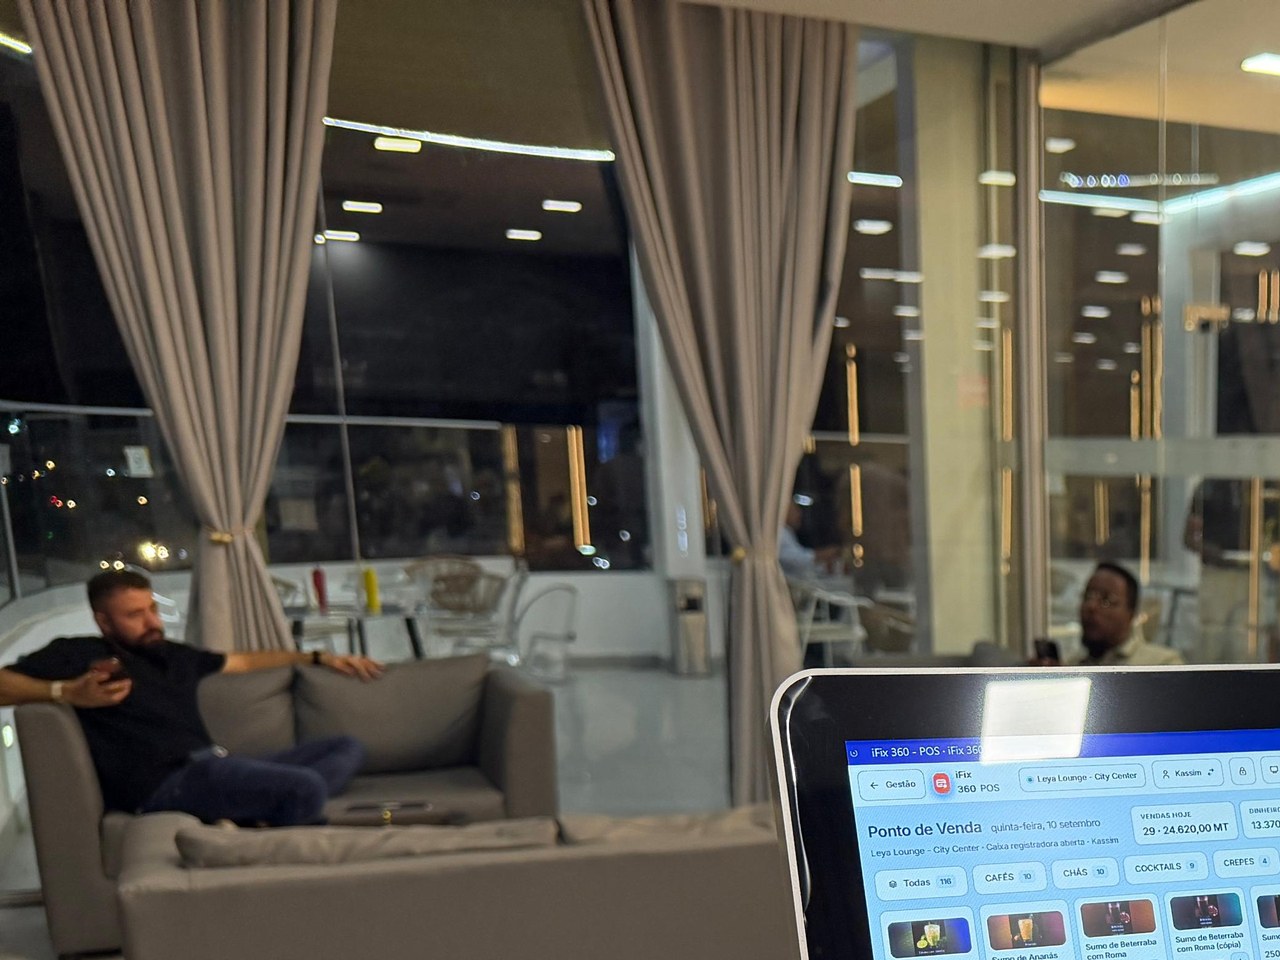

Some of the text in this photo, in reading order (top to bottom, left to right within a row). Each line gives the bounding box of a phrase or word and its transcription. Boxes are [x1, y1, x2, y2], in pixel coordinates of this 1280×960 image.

[871, 748, 888, 757] iFix
[891, 747, 909, 757] 360
[920, 746, 940, 756] POS
[948, 745, 965, 755] iFix
[956, 771, 971, 779] iFix
[1037, 771, 1137, 784] Leya Lounge City Center
[886, 779, 916, 789] Gestão
[958, 783, 999, 793] 360 POS
[868, 822, 982, 838] Ponto de Venda
[991, 818, 1101, 833] quinta-feira, 10 setembro
[1143, 823, 1229, 836] 29 24.620,00 MT
[871, 836, 1119, 858] Leya Lounge City Center Caixa registradora aberta Kassim
[1224, 858, 1254, 867] CREPES
[1063, 868, 1105, 878] CHÁS 10
[1135, 863, 1181, 873] COCKTAILS
[985, 872, 1014, 883] CAFÉS
[903, 878, 931, 888] Todas
[1208, 931, 1244, 941] Beterraba
[1216, 941, 1241, 950] (cópia)
